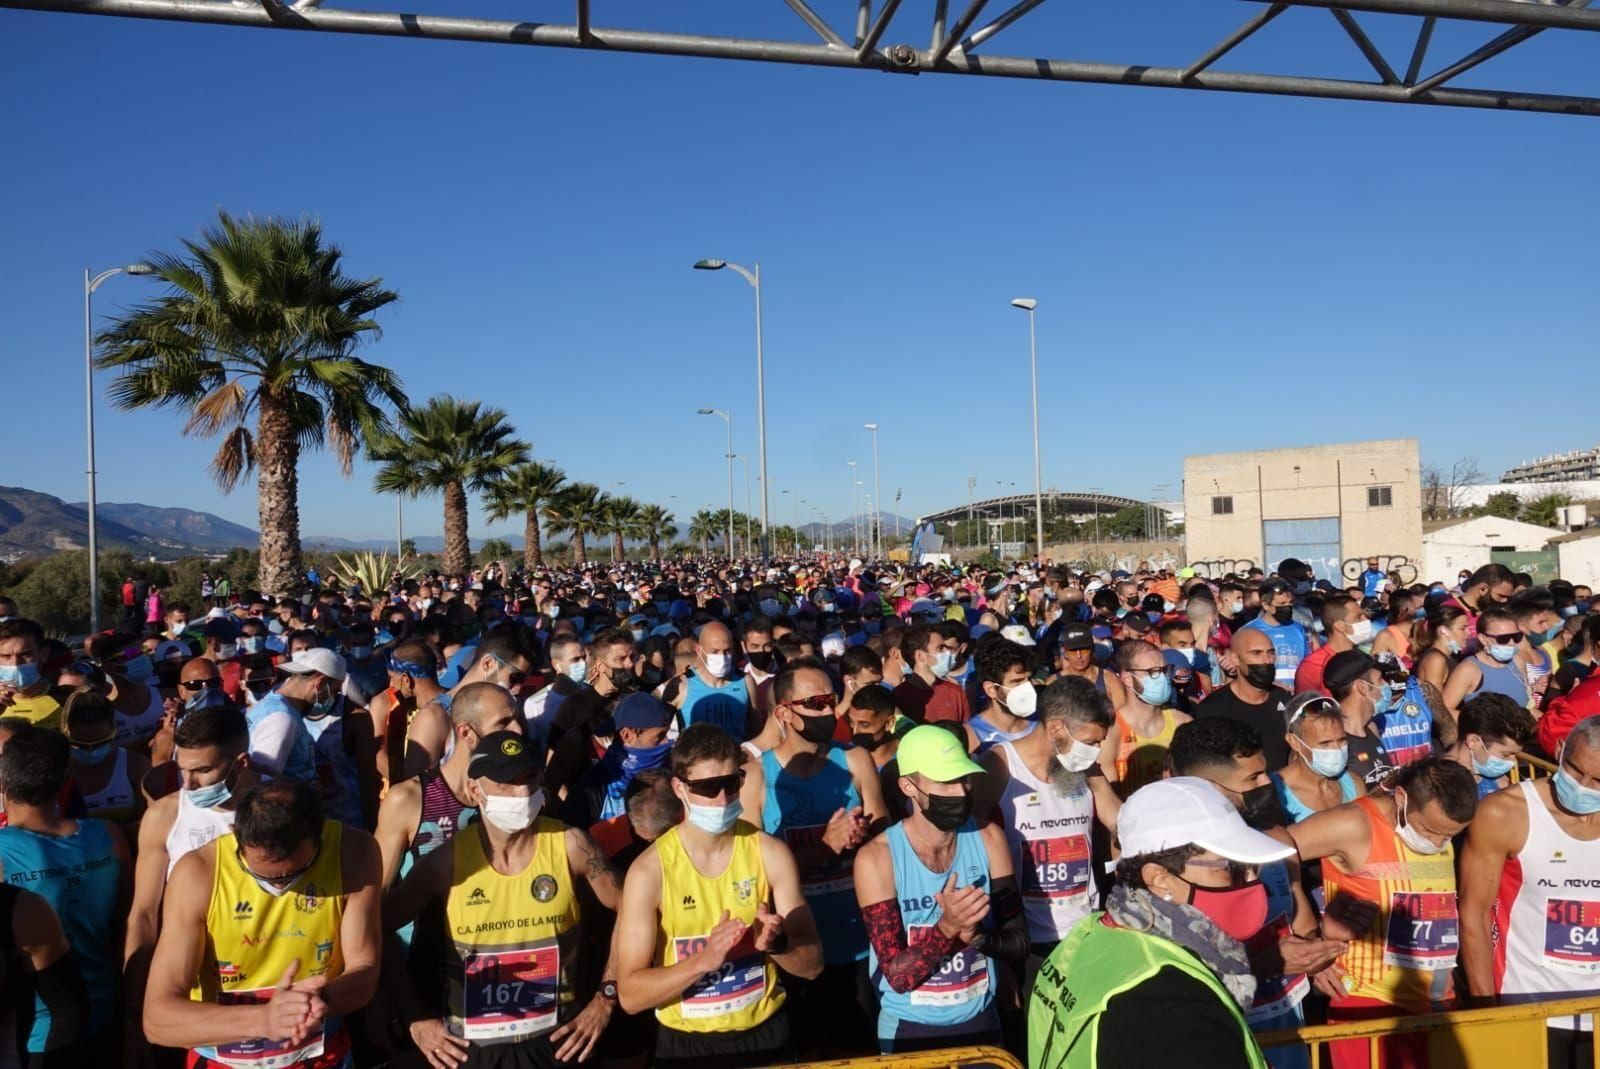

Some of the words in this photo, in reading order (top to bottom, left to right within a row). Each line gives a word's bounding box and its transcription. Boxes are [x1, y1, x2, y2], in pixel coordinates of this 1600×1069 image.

[1020, 822, 1036, 830] AL
[1036, 863, 1068, 883] 158
[1537, 879, 1558, 888] AL
[1548, 898, 1582, 926] 30
[475, 920, 515, 933] ARROYO
[517, 919, 529, 928] DE
[532, 917, 544, 926] LA
[1411, 920, 1433, 940] 77
[1569, 926, 1600, 946] 64
[481, 981, 525, 1005] 167
